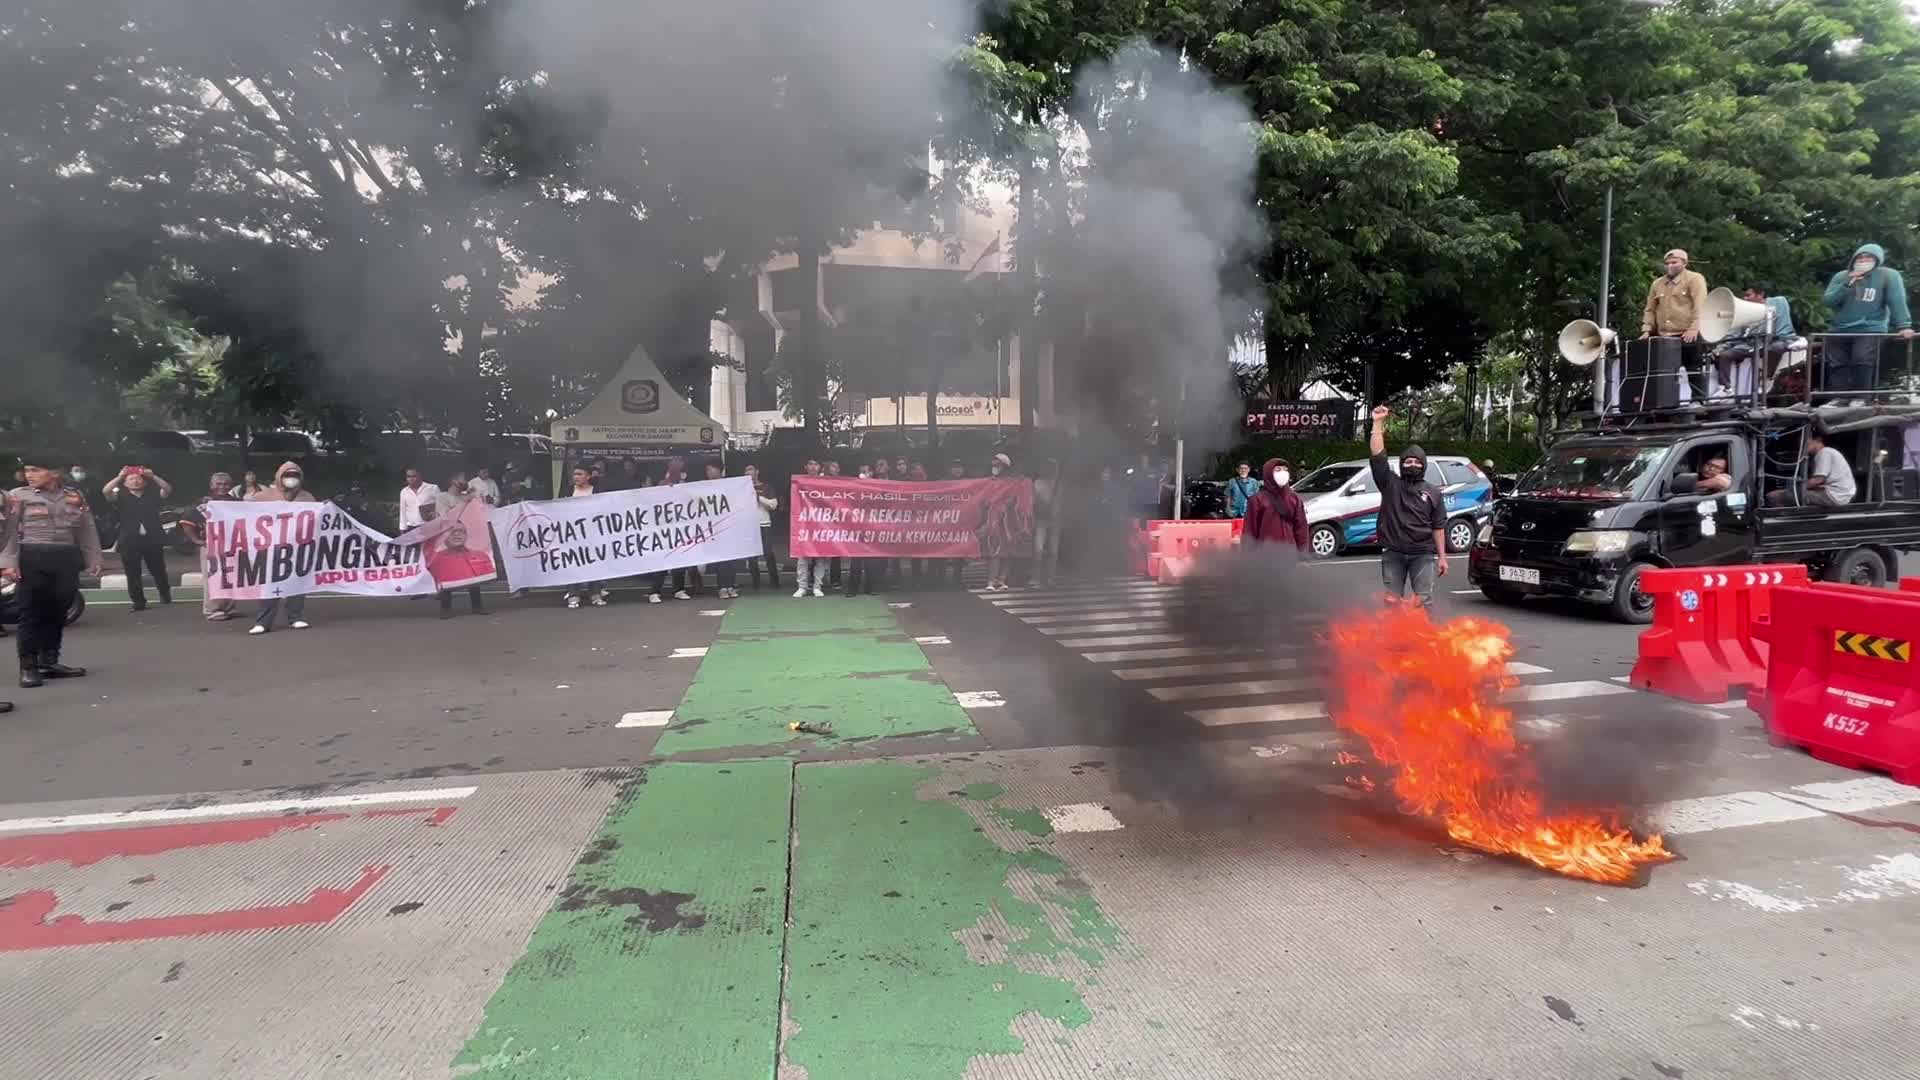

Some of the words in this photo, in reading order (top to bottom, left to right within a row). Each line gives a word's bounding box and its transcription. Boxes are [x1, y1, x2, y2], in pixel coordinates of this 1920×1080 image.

[1246, 413, 1267, 426] PT
[1274, 413, 1337, 426] INDOSAT
[798, 489, 856, 500] TOLAK
[860, 491, 908, 501] HASIL
[912, 492, 971, 502] PEMILU
[516, 518, 588, 550] RAKYAT
[592, 507, 649, 532] TIDAK
[654, 493, 731, 527] PERCAYA
[798, 506, 849, 523] AKIBAT
[852, 508, 866, 523] SI
[915, 509, 929, 524] SI
[932, 509, 961, 524] KPU
[207, 510, 315, 561] HASTO
[321, 513, 359, 531] SAN
[798, 529, 809, 542] SI
[812, 530, 862, 543] KEPARAT
[864, 530, 876, 544] SI
[878, 530, 902, 544] GILA
[905, 530, 970, 545] KEKUASAAN
[539, 543, 607, 573] PEMILU
[315, 569, 358, 586] KPU
[1823, 712, 1870, 736] K552
